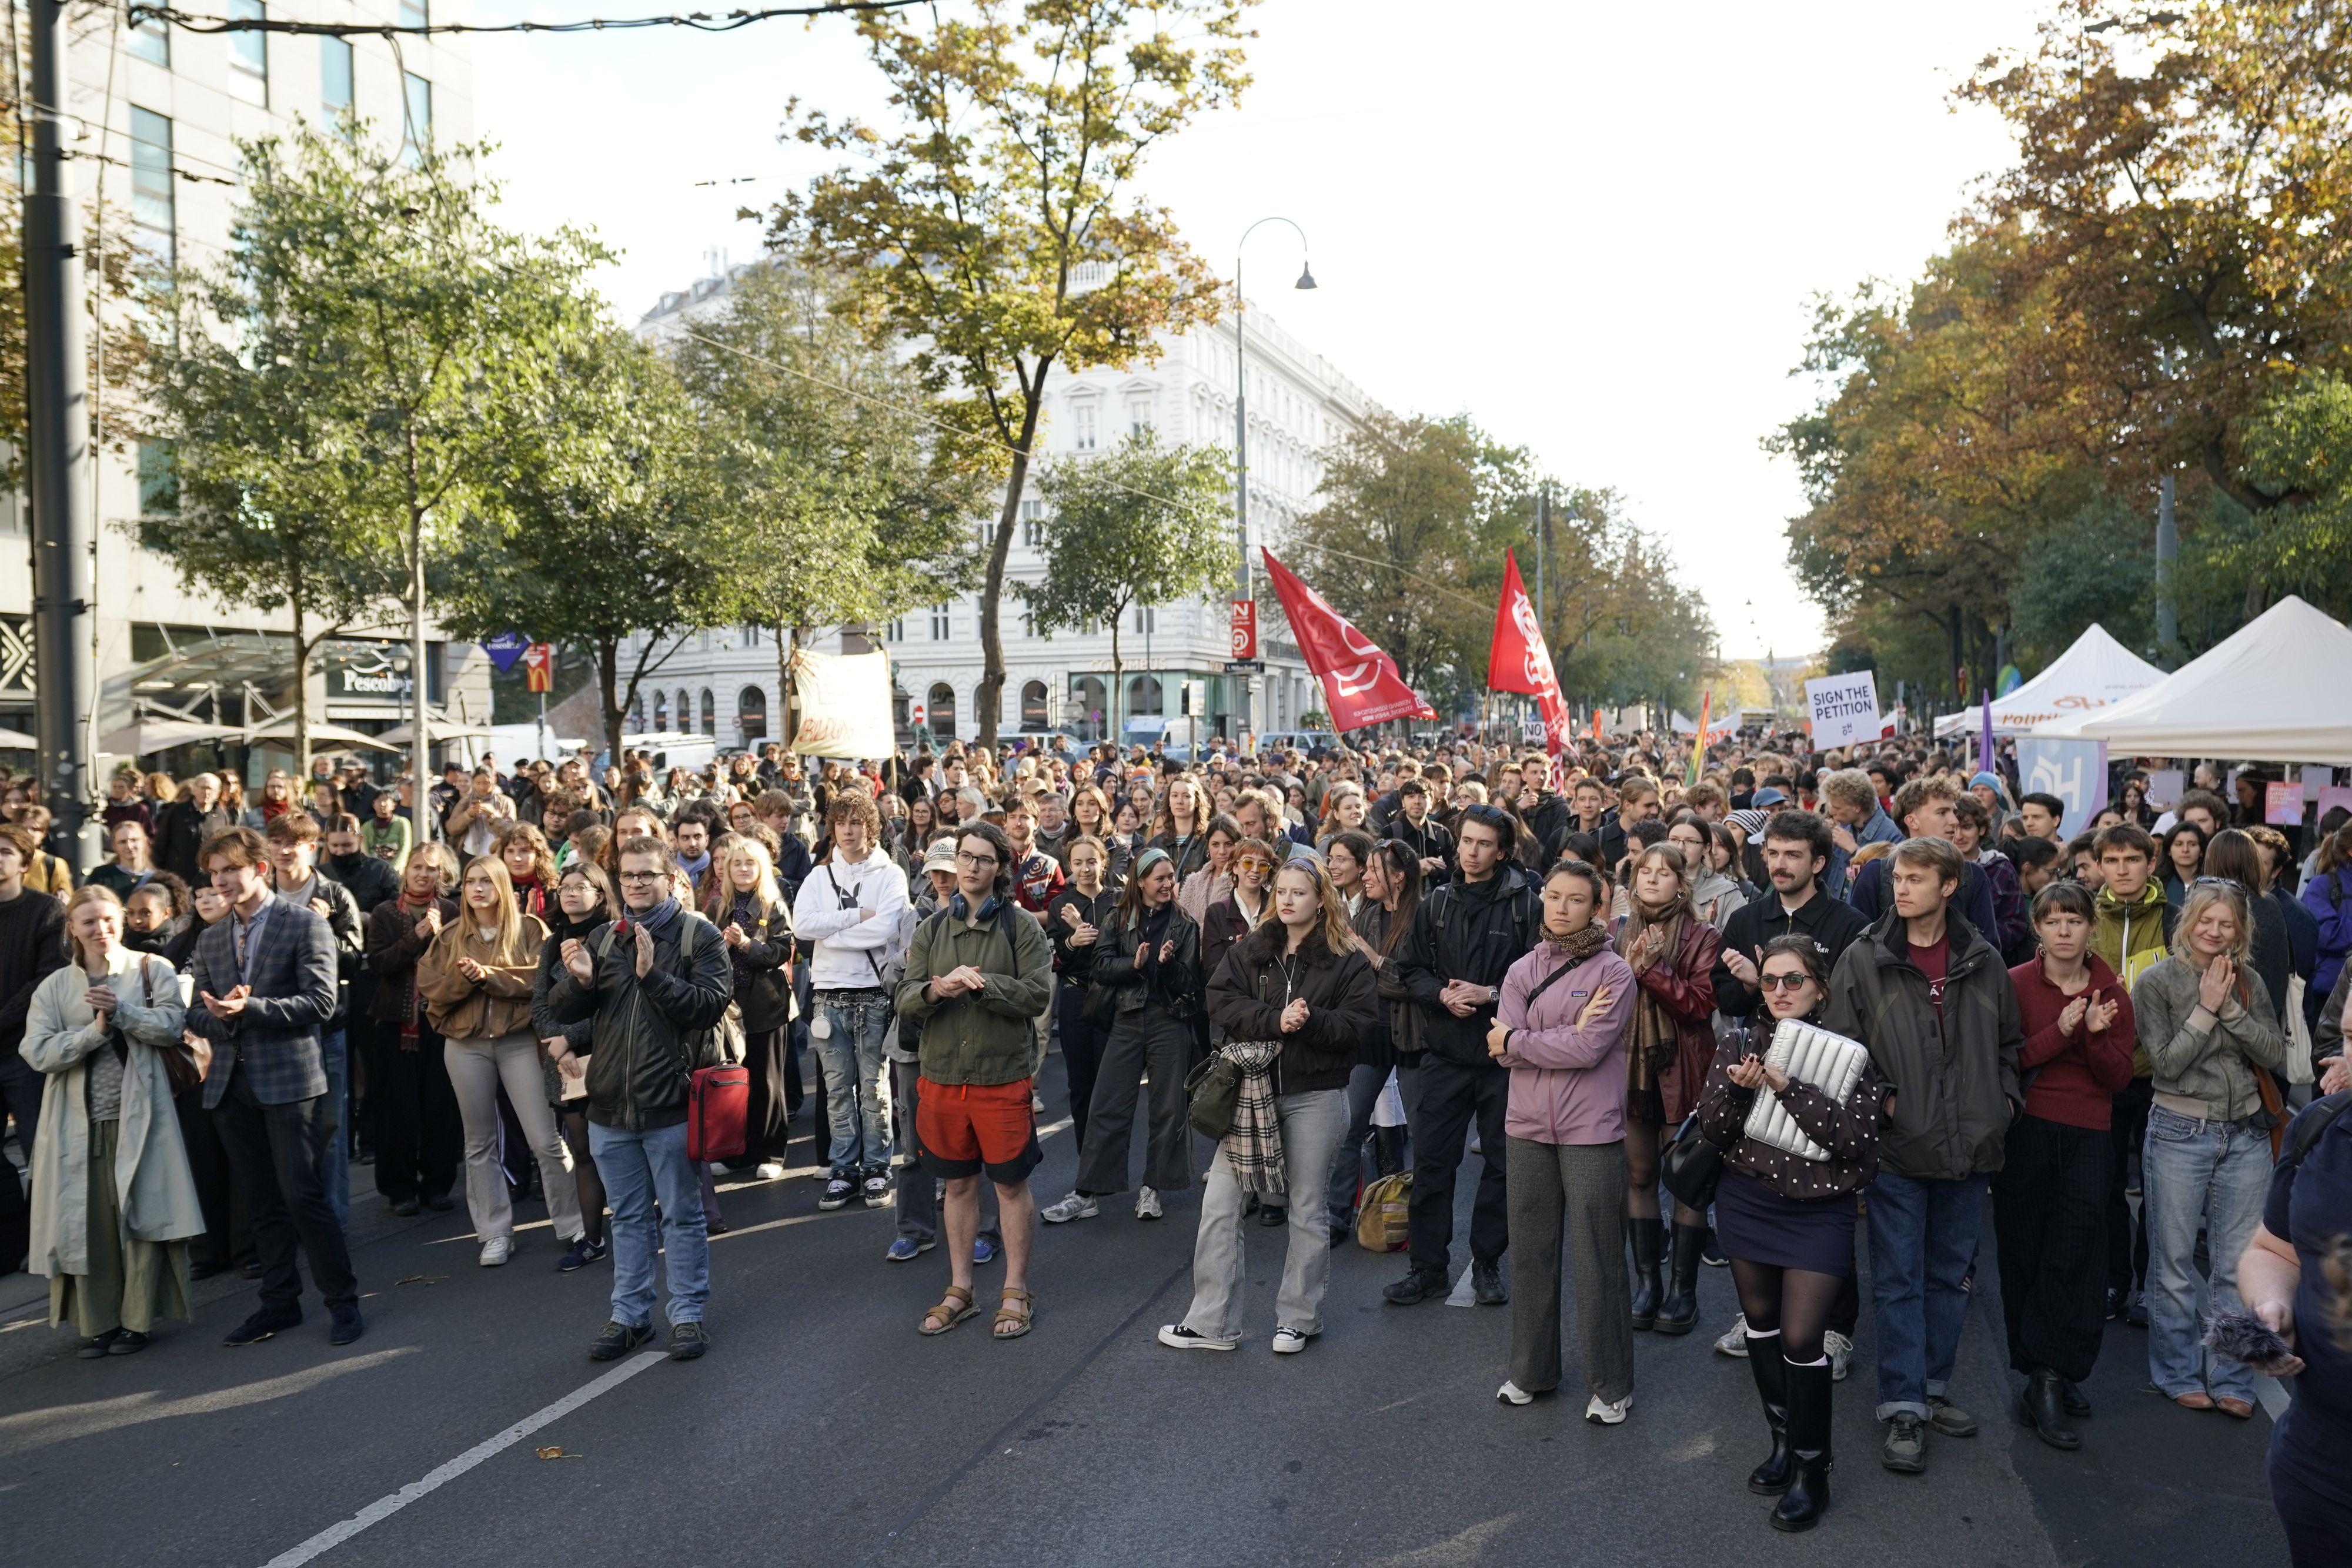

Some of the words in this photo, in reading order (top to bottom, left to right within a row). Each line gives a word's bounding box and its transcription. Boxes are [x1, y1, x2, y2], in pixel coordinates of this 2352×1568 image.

[1813, 690, 1844, 706] SIGN
[1845, 685, 1870, 701] THE
[1816, 700, 1873, 721] PETITION
[1525, 724, 1542, 736] NO
